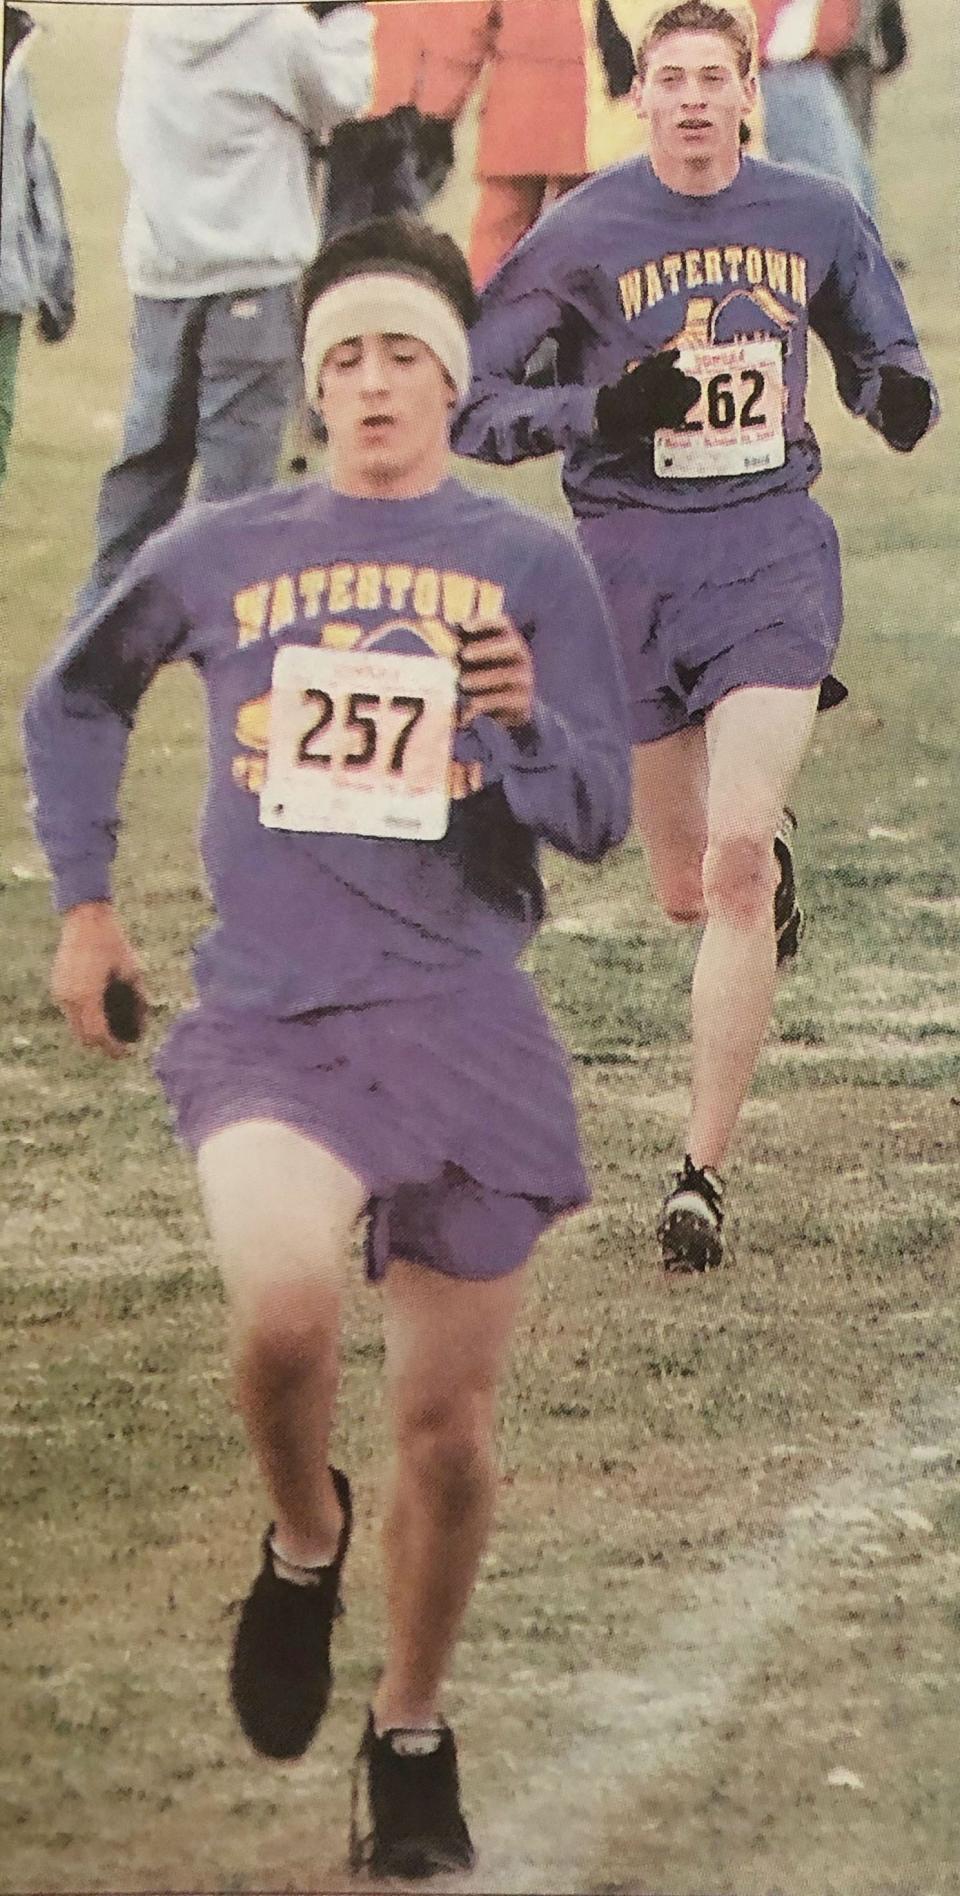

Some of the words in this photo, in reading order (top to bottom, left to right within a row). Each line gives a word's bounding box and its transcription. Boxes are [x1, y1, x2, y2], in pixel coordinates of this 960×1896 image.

[618, 245, 807, 321] WATERTOWN
[674, 369, 767, 431] 262
[234, 562, 504, 649] WATERTOWN
[298, 688, 426, 775] 257
